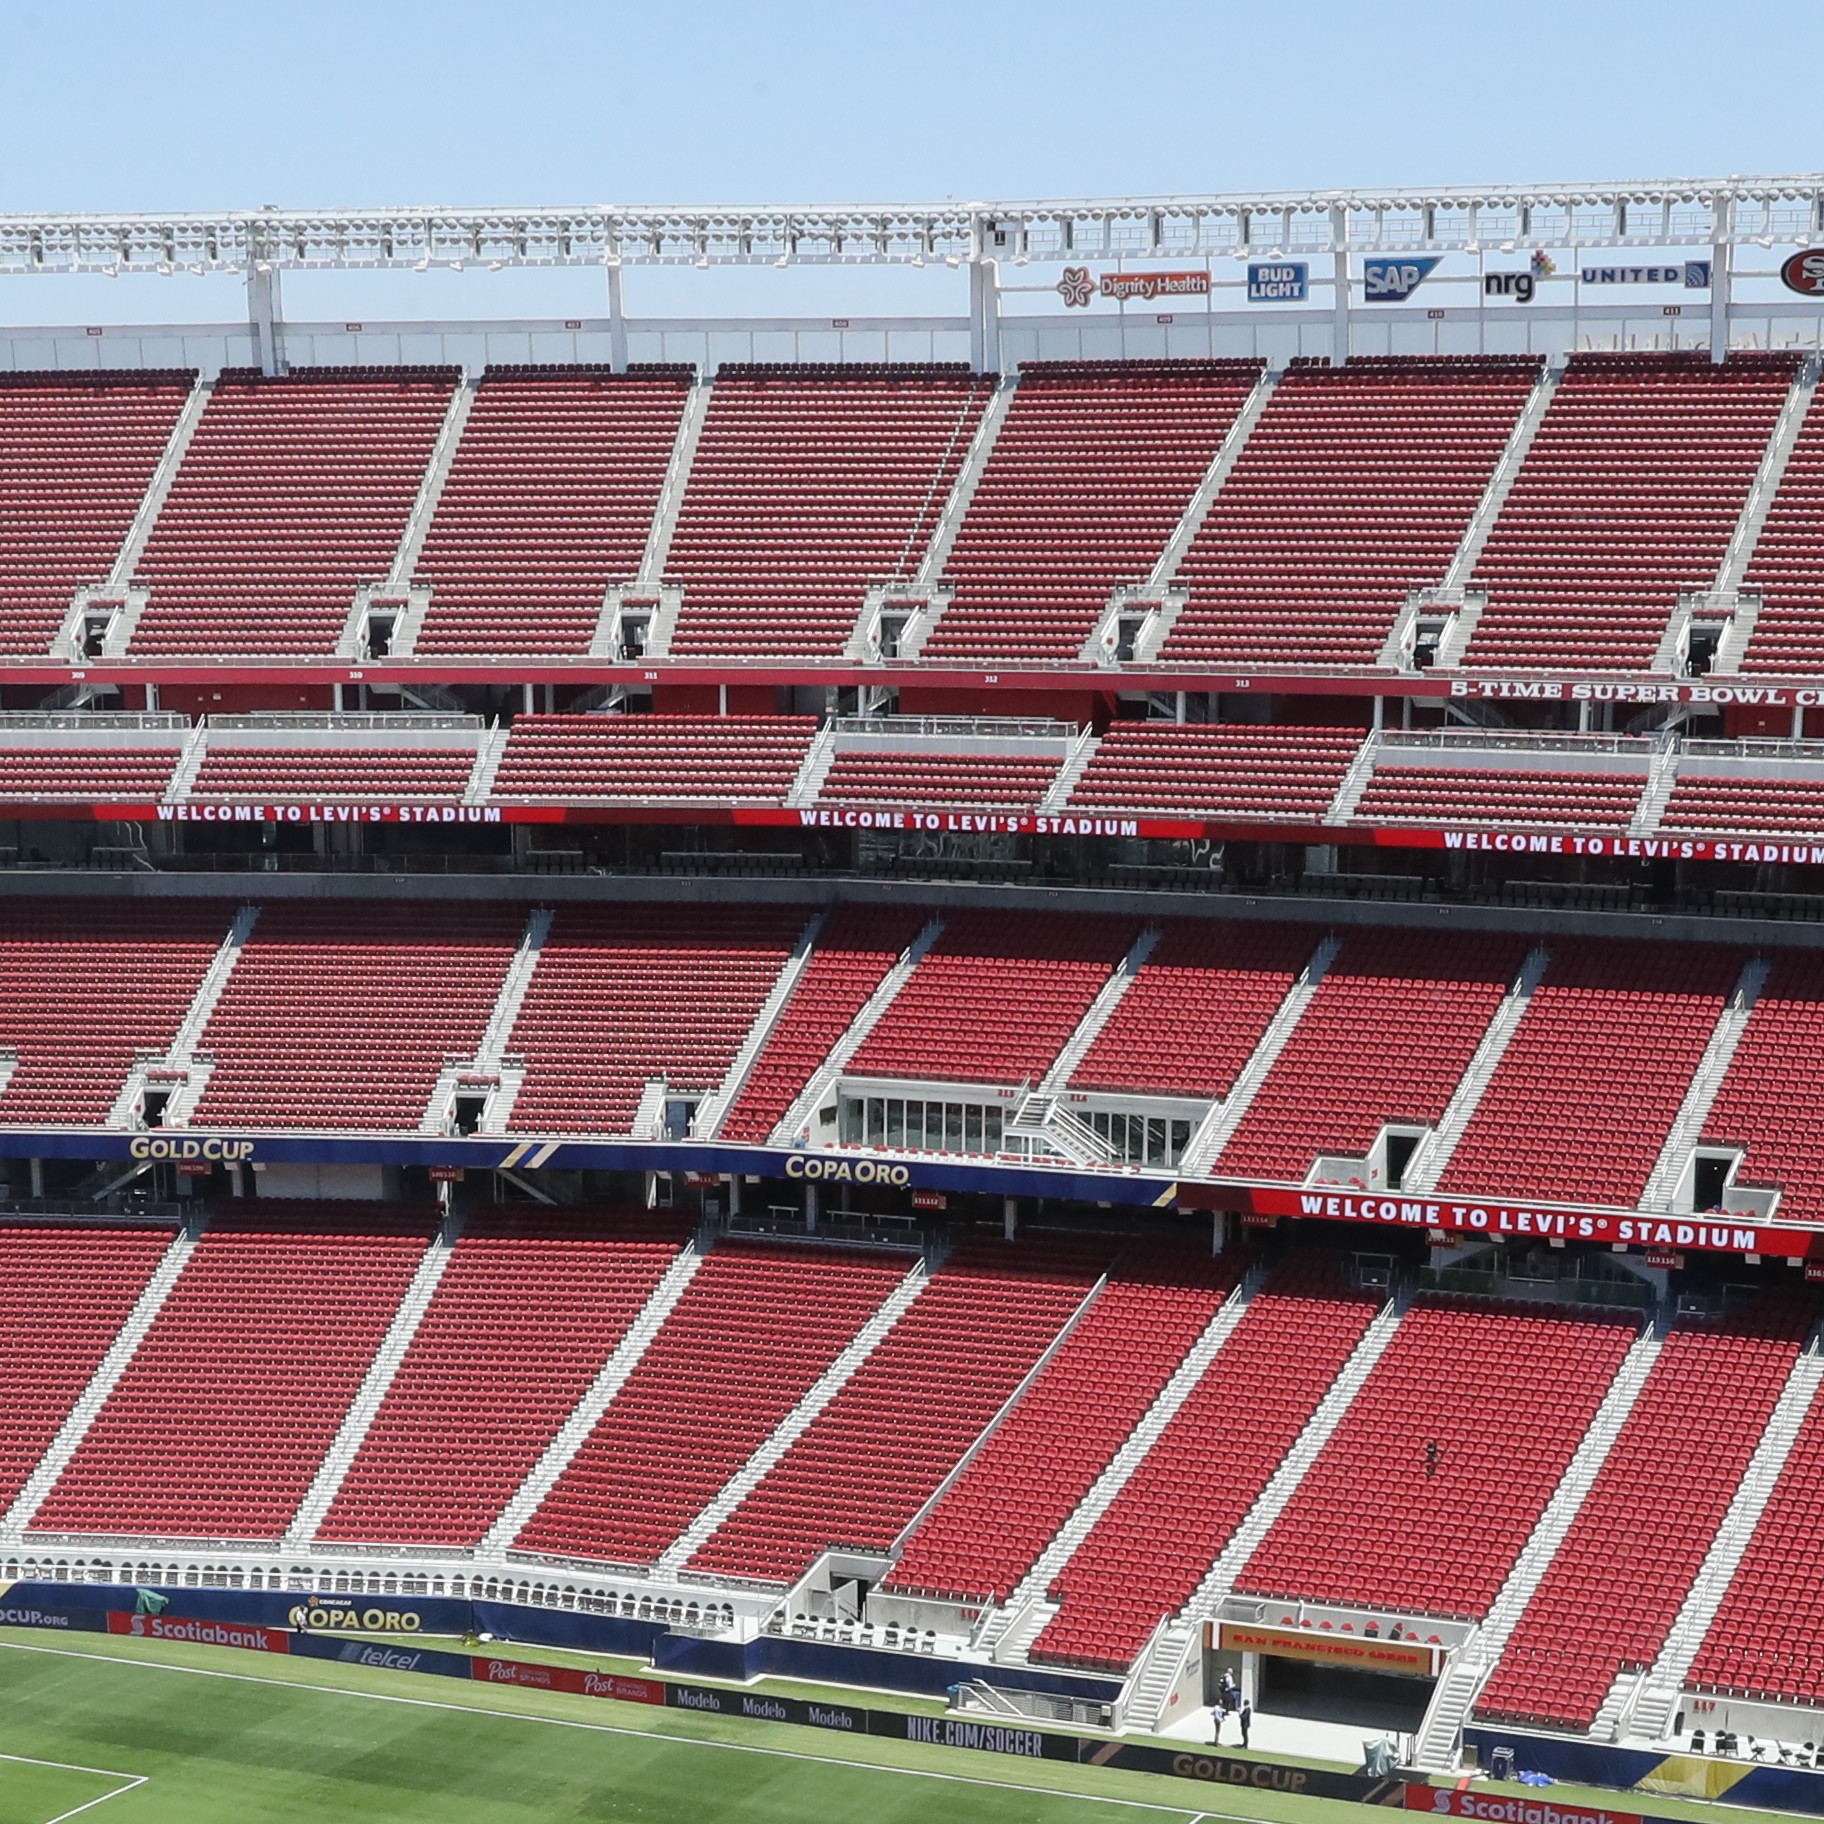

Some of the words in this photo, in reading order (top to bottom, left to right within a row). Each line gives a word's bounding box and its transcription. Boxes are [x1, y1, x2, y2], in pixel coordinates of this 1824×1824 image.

[1258, 267, 1295, 282] BUD
[1366, 266, 1420, 295] SAP
[1583, 268, 1679, 283] UNITED
[1101, 275, 1154, 298] Dignity
[1157, 275, 1208, 293] Health
[1251, 282, 1303, 298] LIGHT
[1484, 274, 1534, 302] nrg
[1451, 681, 1562, 699] 5-TIME
[1572, 683, 1680, 701] SUPER
[1689, 686, 1786, 705] BOWL
[157, 805, 265, 821] WELCOME
[274, 805, 302, 821] TO
[399, 807, 501, 822] STADIUM
[799, 810, 905, 828] WELCOME
[913, 814, 940, 829] TO
[1036, 818, 1137, 836] STADIUM
[1444, 832, 1563, 853] WELCOME
[1573, 837, 1603, 854] TO
[129, 1136, 200, 1159] GOLD
[202, 1137, 255, 1160] CUP
[785, 1155, 853, 1181] COPA
[854, 1159, 909, 1185] ORO
[1300, 1195, 1440, 1225] WELCOME
[1451, 1206, 1488, 1228] TO
[1618, 1219, 1756, 1250] STADIUM
[362, 1608, 421, 1631] ORO
[151, 1618, 269, 1650] Scotiabank
[1233, 1633, 1268, 1646] SAN
[1271, 1637, 1366, 1658] FRANCISCO
[359, 1644, 421, 1671] telcel
[488, 1660, 518, 1681] Post
[584, 1673, 615, 1694] Post
[677, 1689, 720, 1710] Modelo
[742, 1697, 786, 1719] Modelo
[808, 1706, 852, 1729] Modelo
[907, 1715, 1043, 1758] NIKE.COM/SOCCER
[1172, 1753, 1248, 1783] GOLD
[1250, 1764, 1308, 1793] CUP
